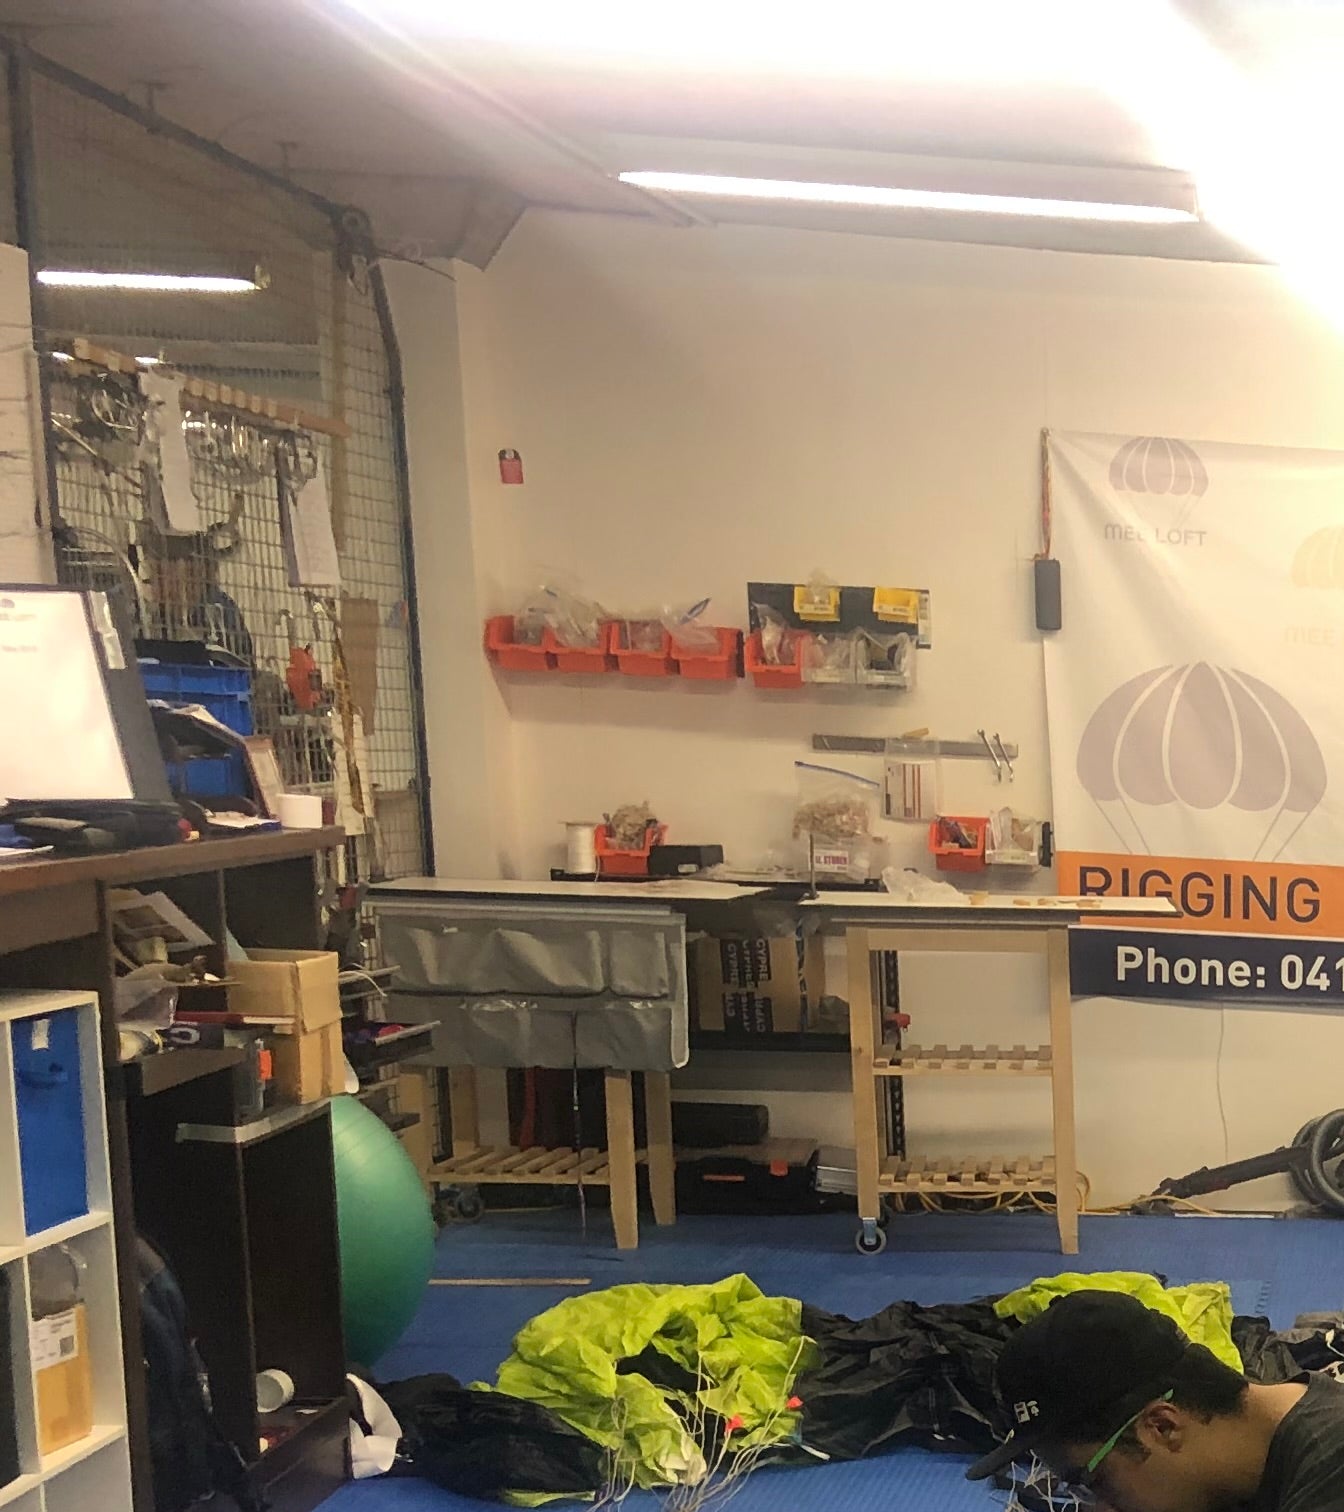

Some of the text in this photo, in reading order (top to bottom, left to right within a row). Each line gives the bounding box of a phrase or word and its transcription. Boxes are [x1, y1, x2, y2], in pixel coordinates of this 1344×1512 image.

[1154, 527, 1208, 546] LOFT
[1078, 865, 1322, 923] RIGGING
[1116, 944, 1267, 989] Phone:
